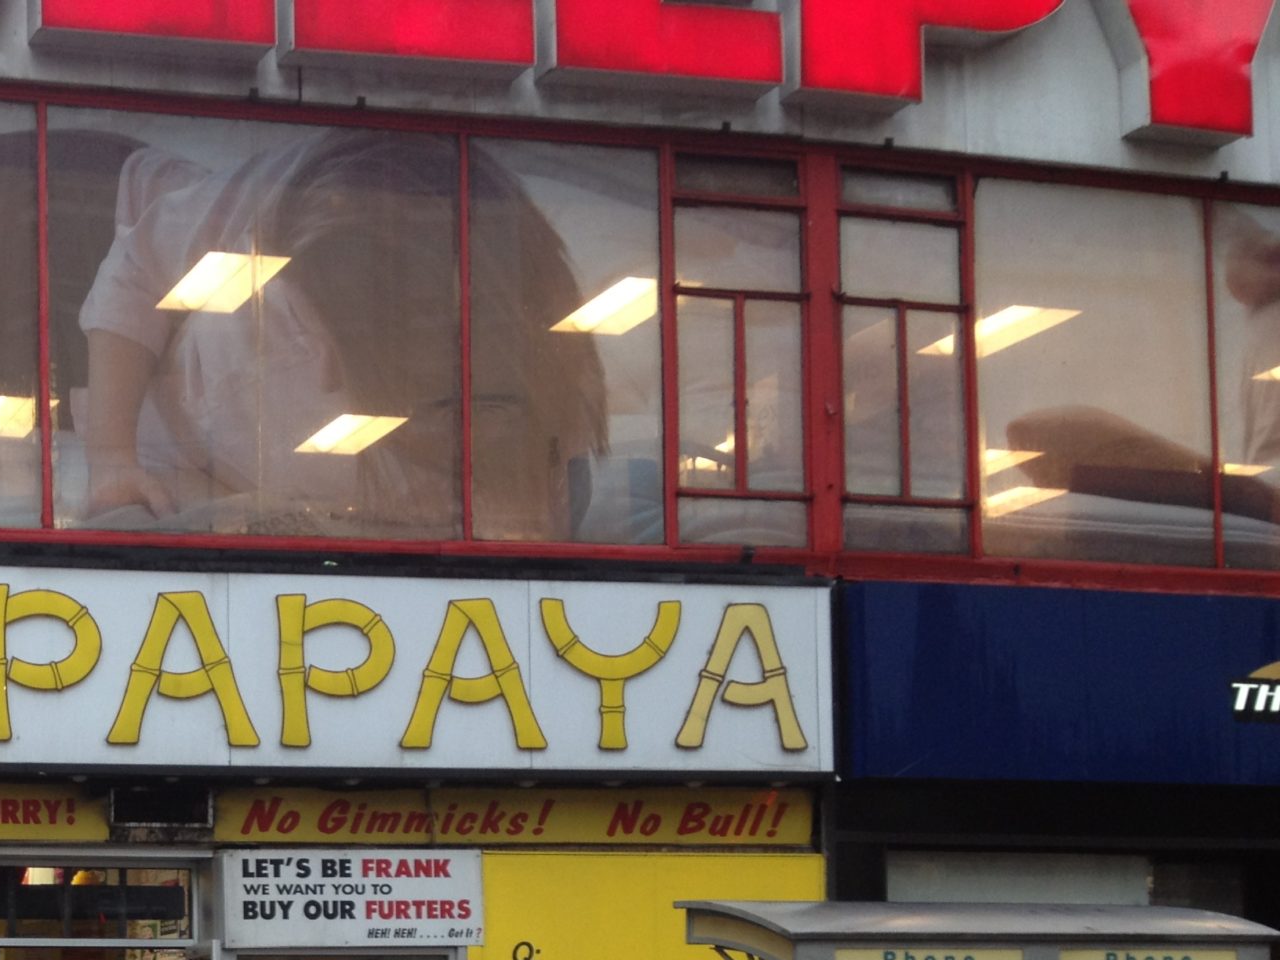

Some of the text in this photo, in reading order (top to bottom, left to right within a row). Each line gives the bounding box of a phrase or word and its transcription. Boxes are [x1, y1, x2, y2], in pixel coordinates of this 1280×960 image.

[240, 797, 550, 837] No Gimmicks!
[606, 801, 789, 838] No Bull!
[241, 857, 452, 879] LET'S BE FRANK
[243, 883, 393, 896] WE WANT YOU TO
[241, 899, 472, 921] BUY OUR FURTERS
